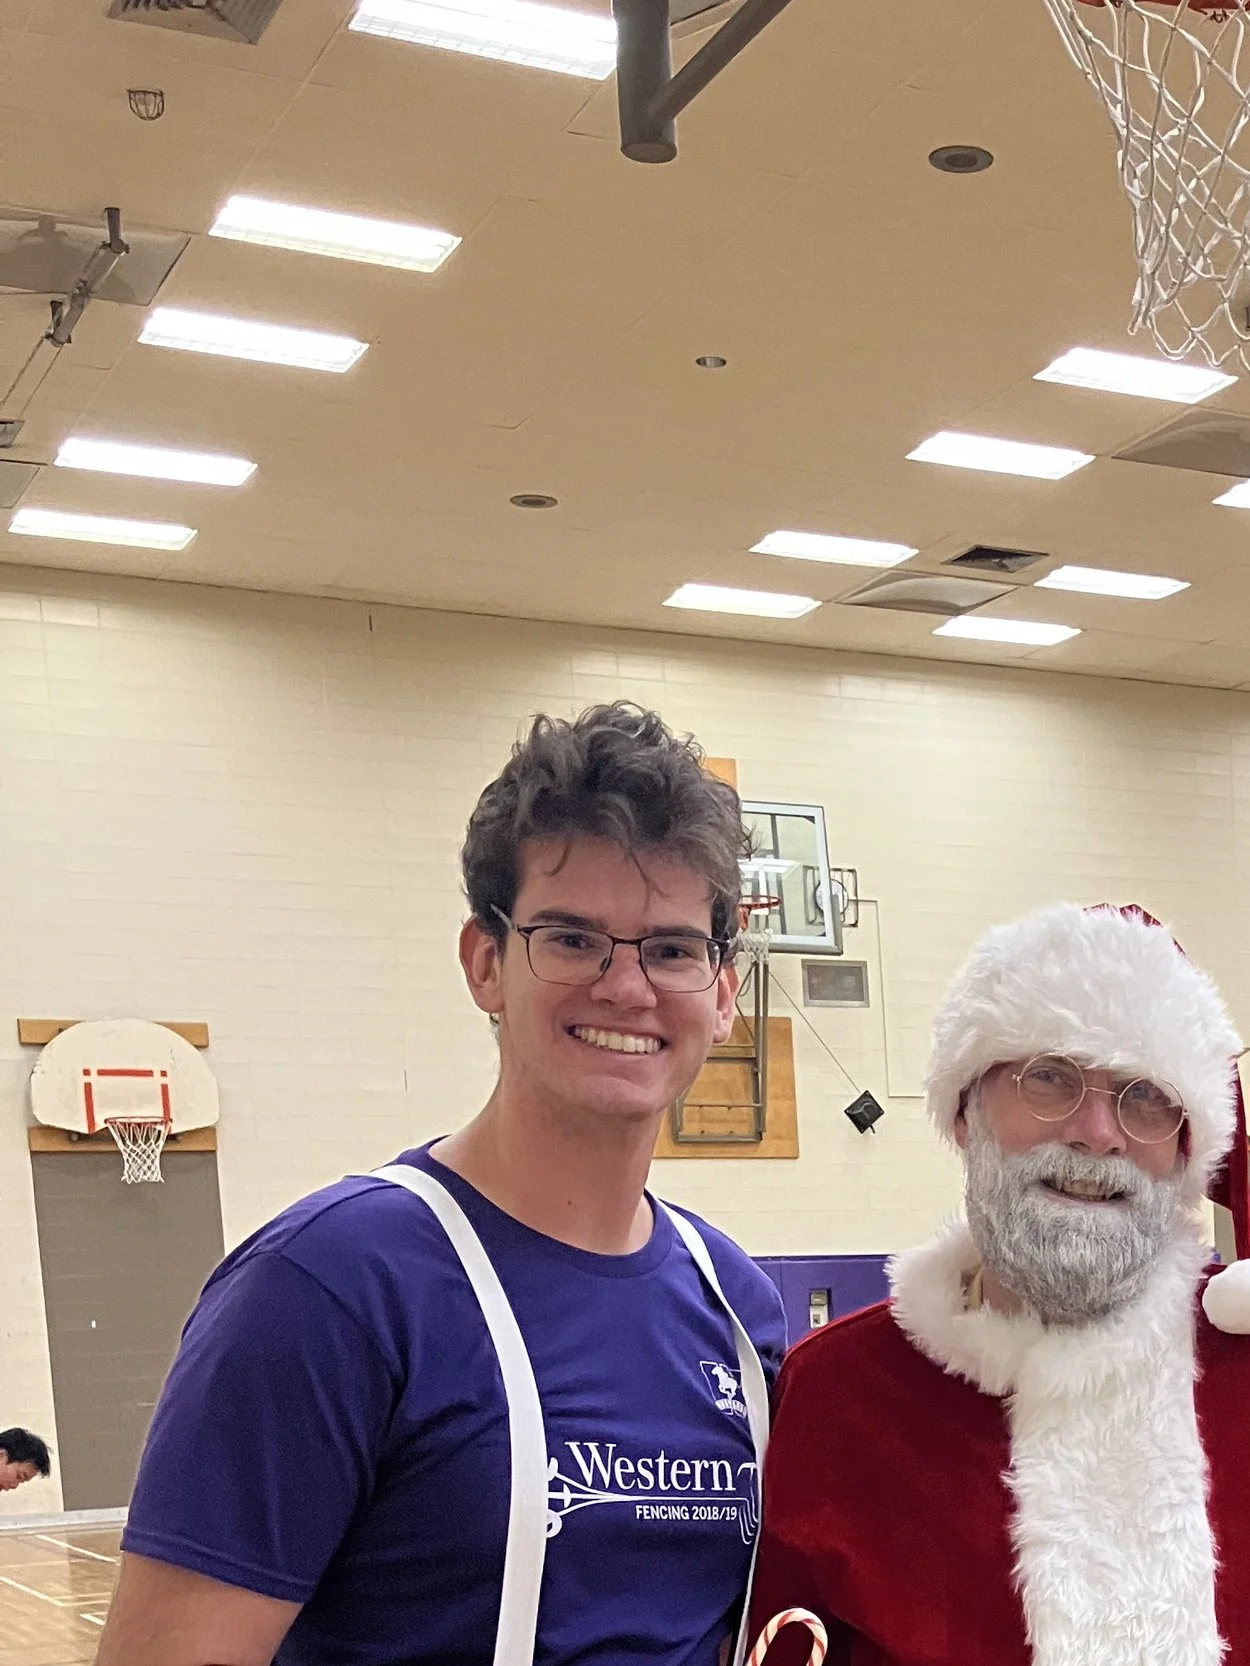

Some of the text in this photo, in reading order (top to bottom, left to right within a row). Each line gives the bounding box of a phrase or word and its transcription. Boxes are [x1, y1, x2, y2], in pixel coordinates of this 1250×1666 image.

[565, 1441, 736, 1491] Western
[635, 1505, 737, 1520] FENCING 2018/19
